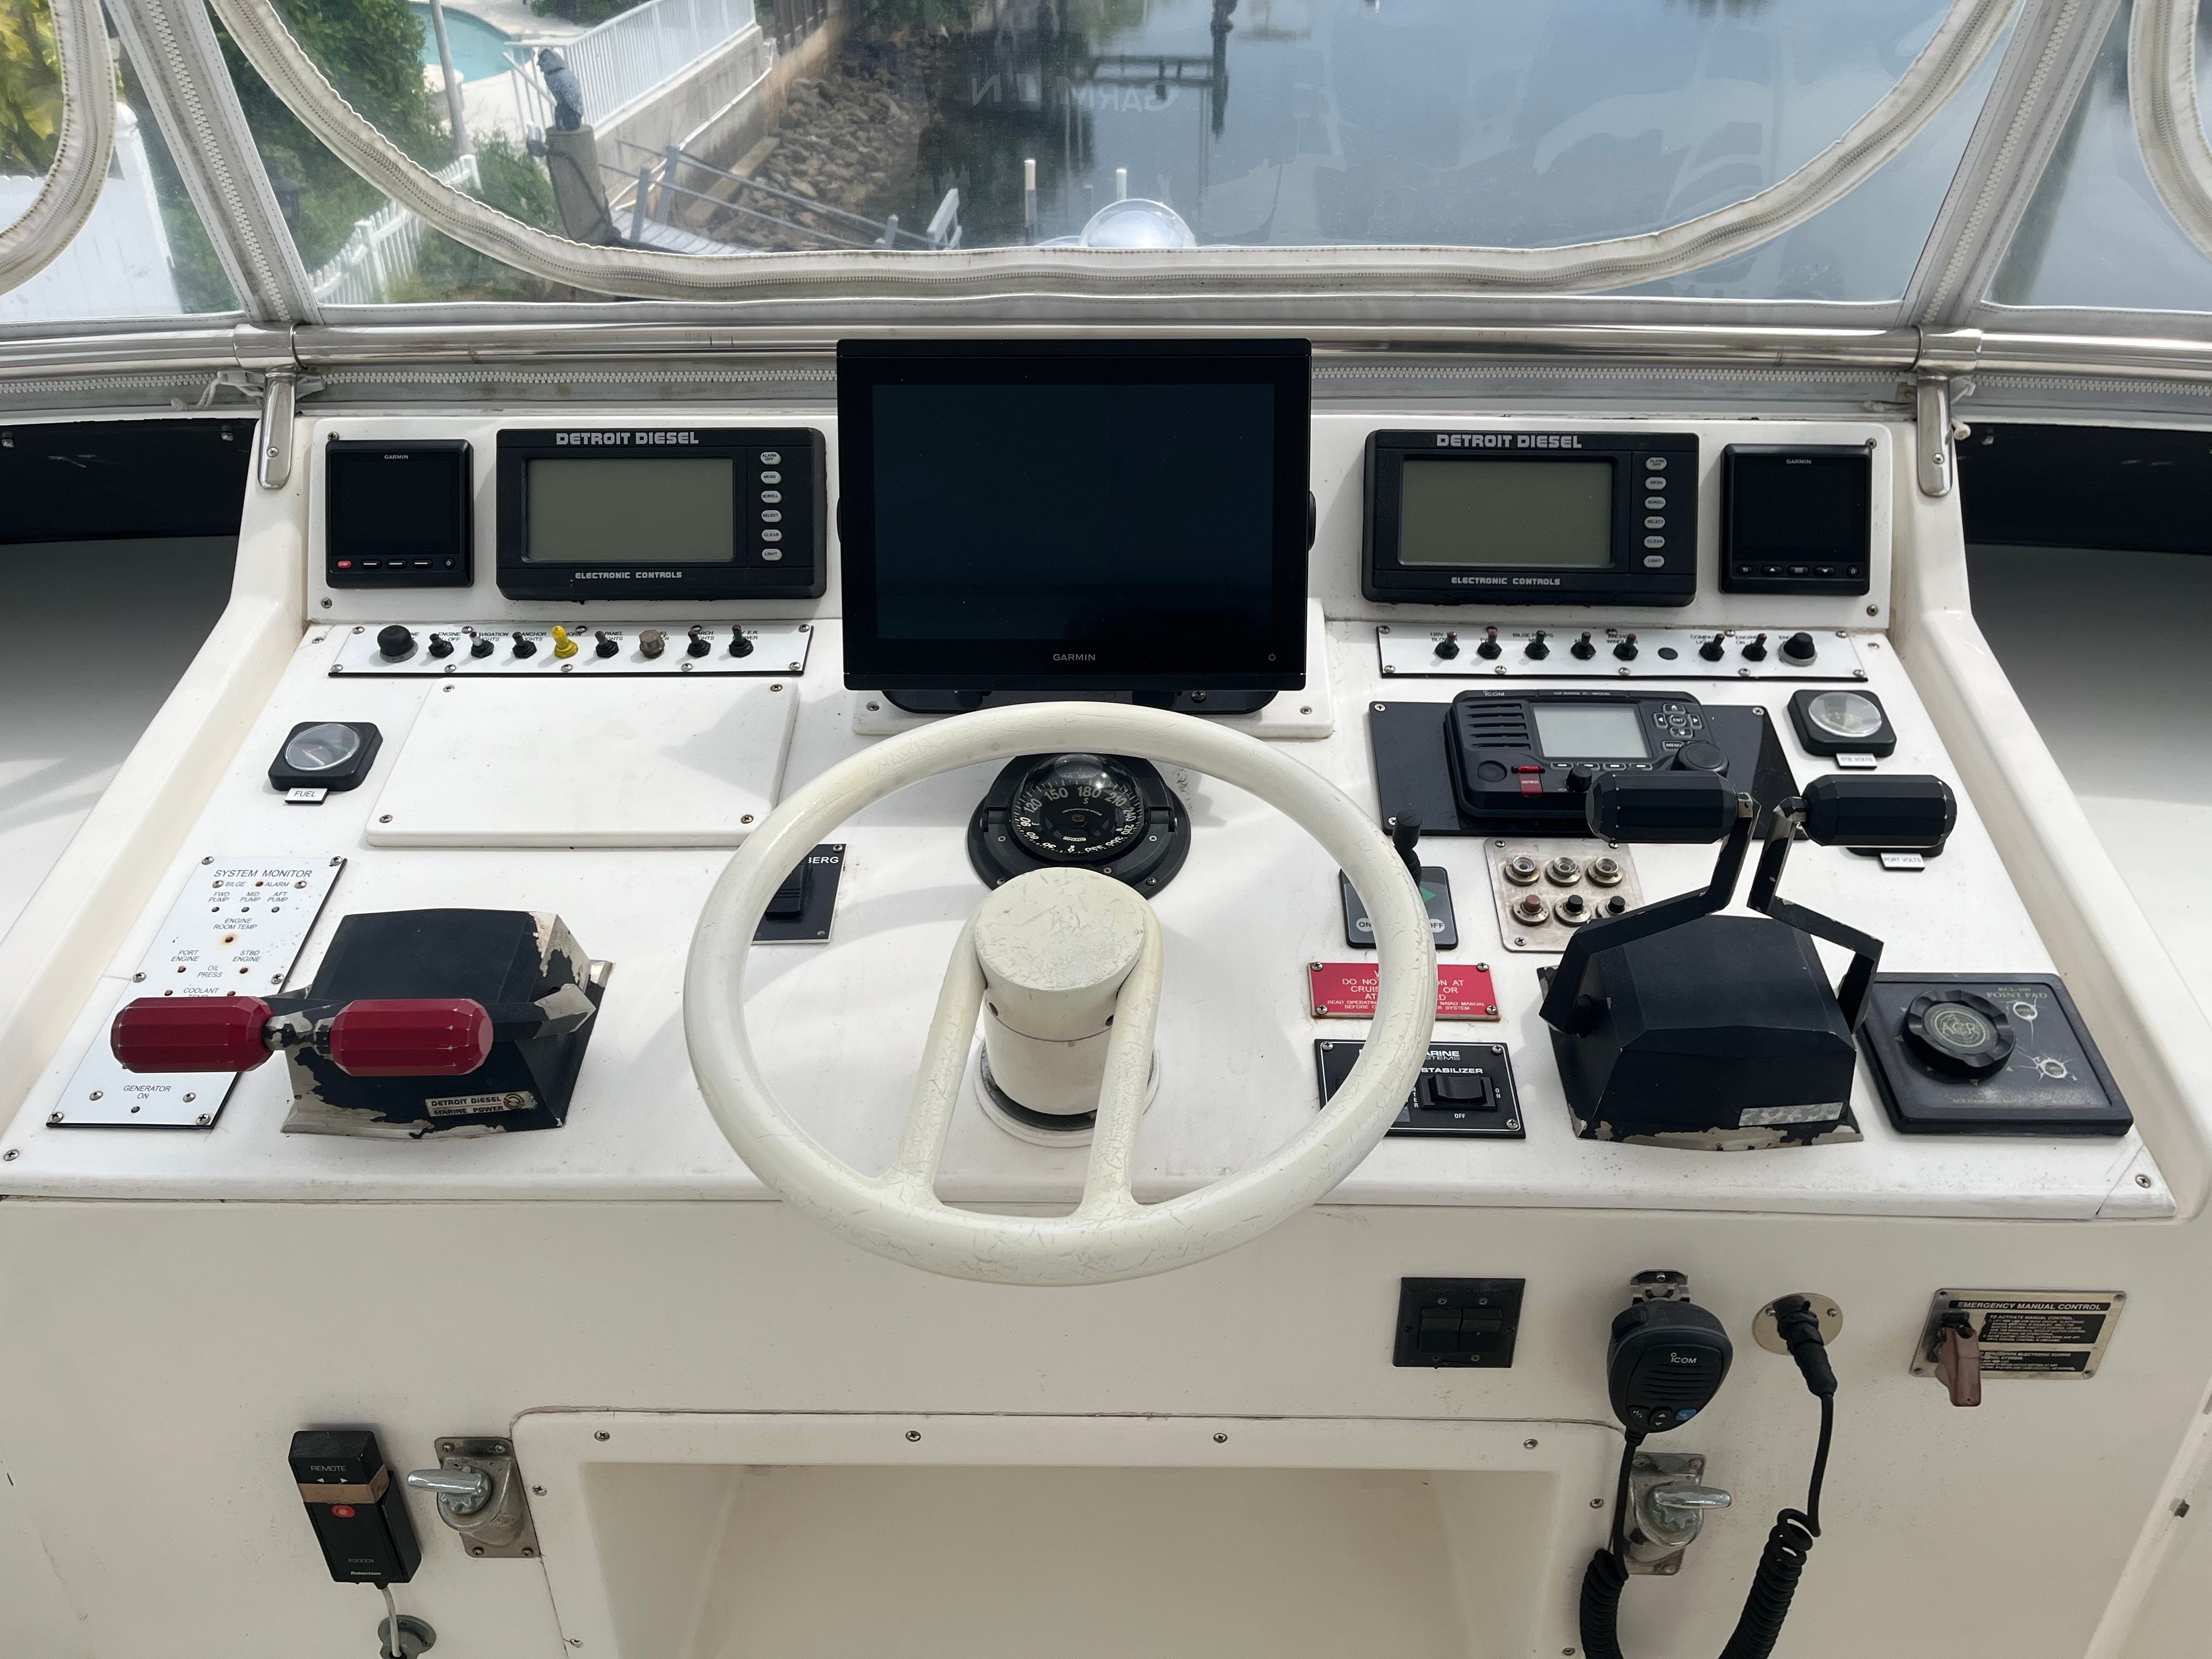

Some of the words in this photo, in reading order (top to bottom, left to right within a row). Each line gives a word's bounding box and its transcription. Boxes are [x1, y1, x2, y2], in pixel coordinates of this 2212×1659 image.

[556, 432, 631, 445] DETROIT
[635, 432, 699, 445] DIESEL
[1437, 434, 1513, 448] DETROIT
[1517, 434, 1582, 449] DIESEL
[1451, 577, 1508, 585] ELECTRONIC
[1044, 787, 1069, 801] 150
[1077, 786, 1102, 798] 180
[1024, 798, 1043, 813] 120
[1105, 793, 1127, 807] 210
[1122, 807, 1136, 822] 240
[214, 870, 258, 878] SYSTEM
[431, 1098, 467, 1107] DETROIT
[1957, 1301, 2016, 1310] EMERGENCY
